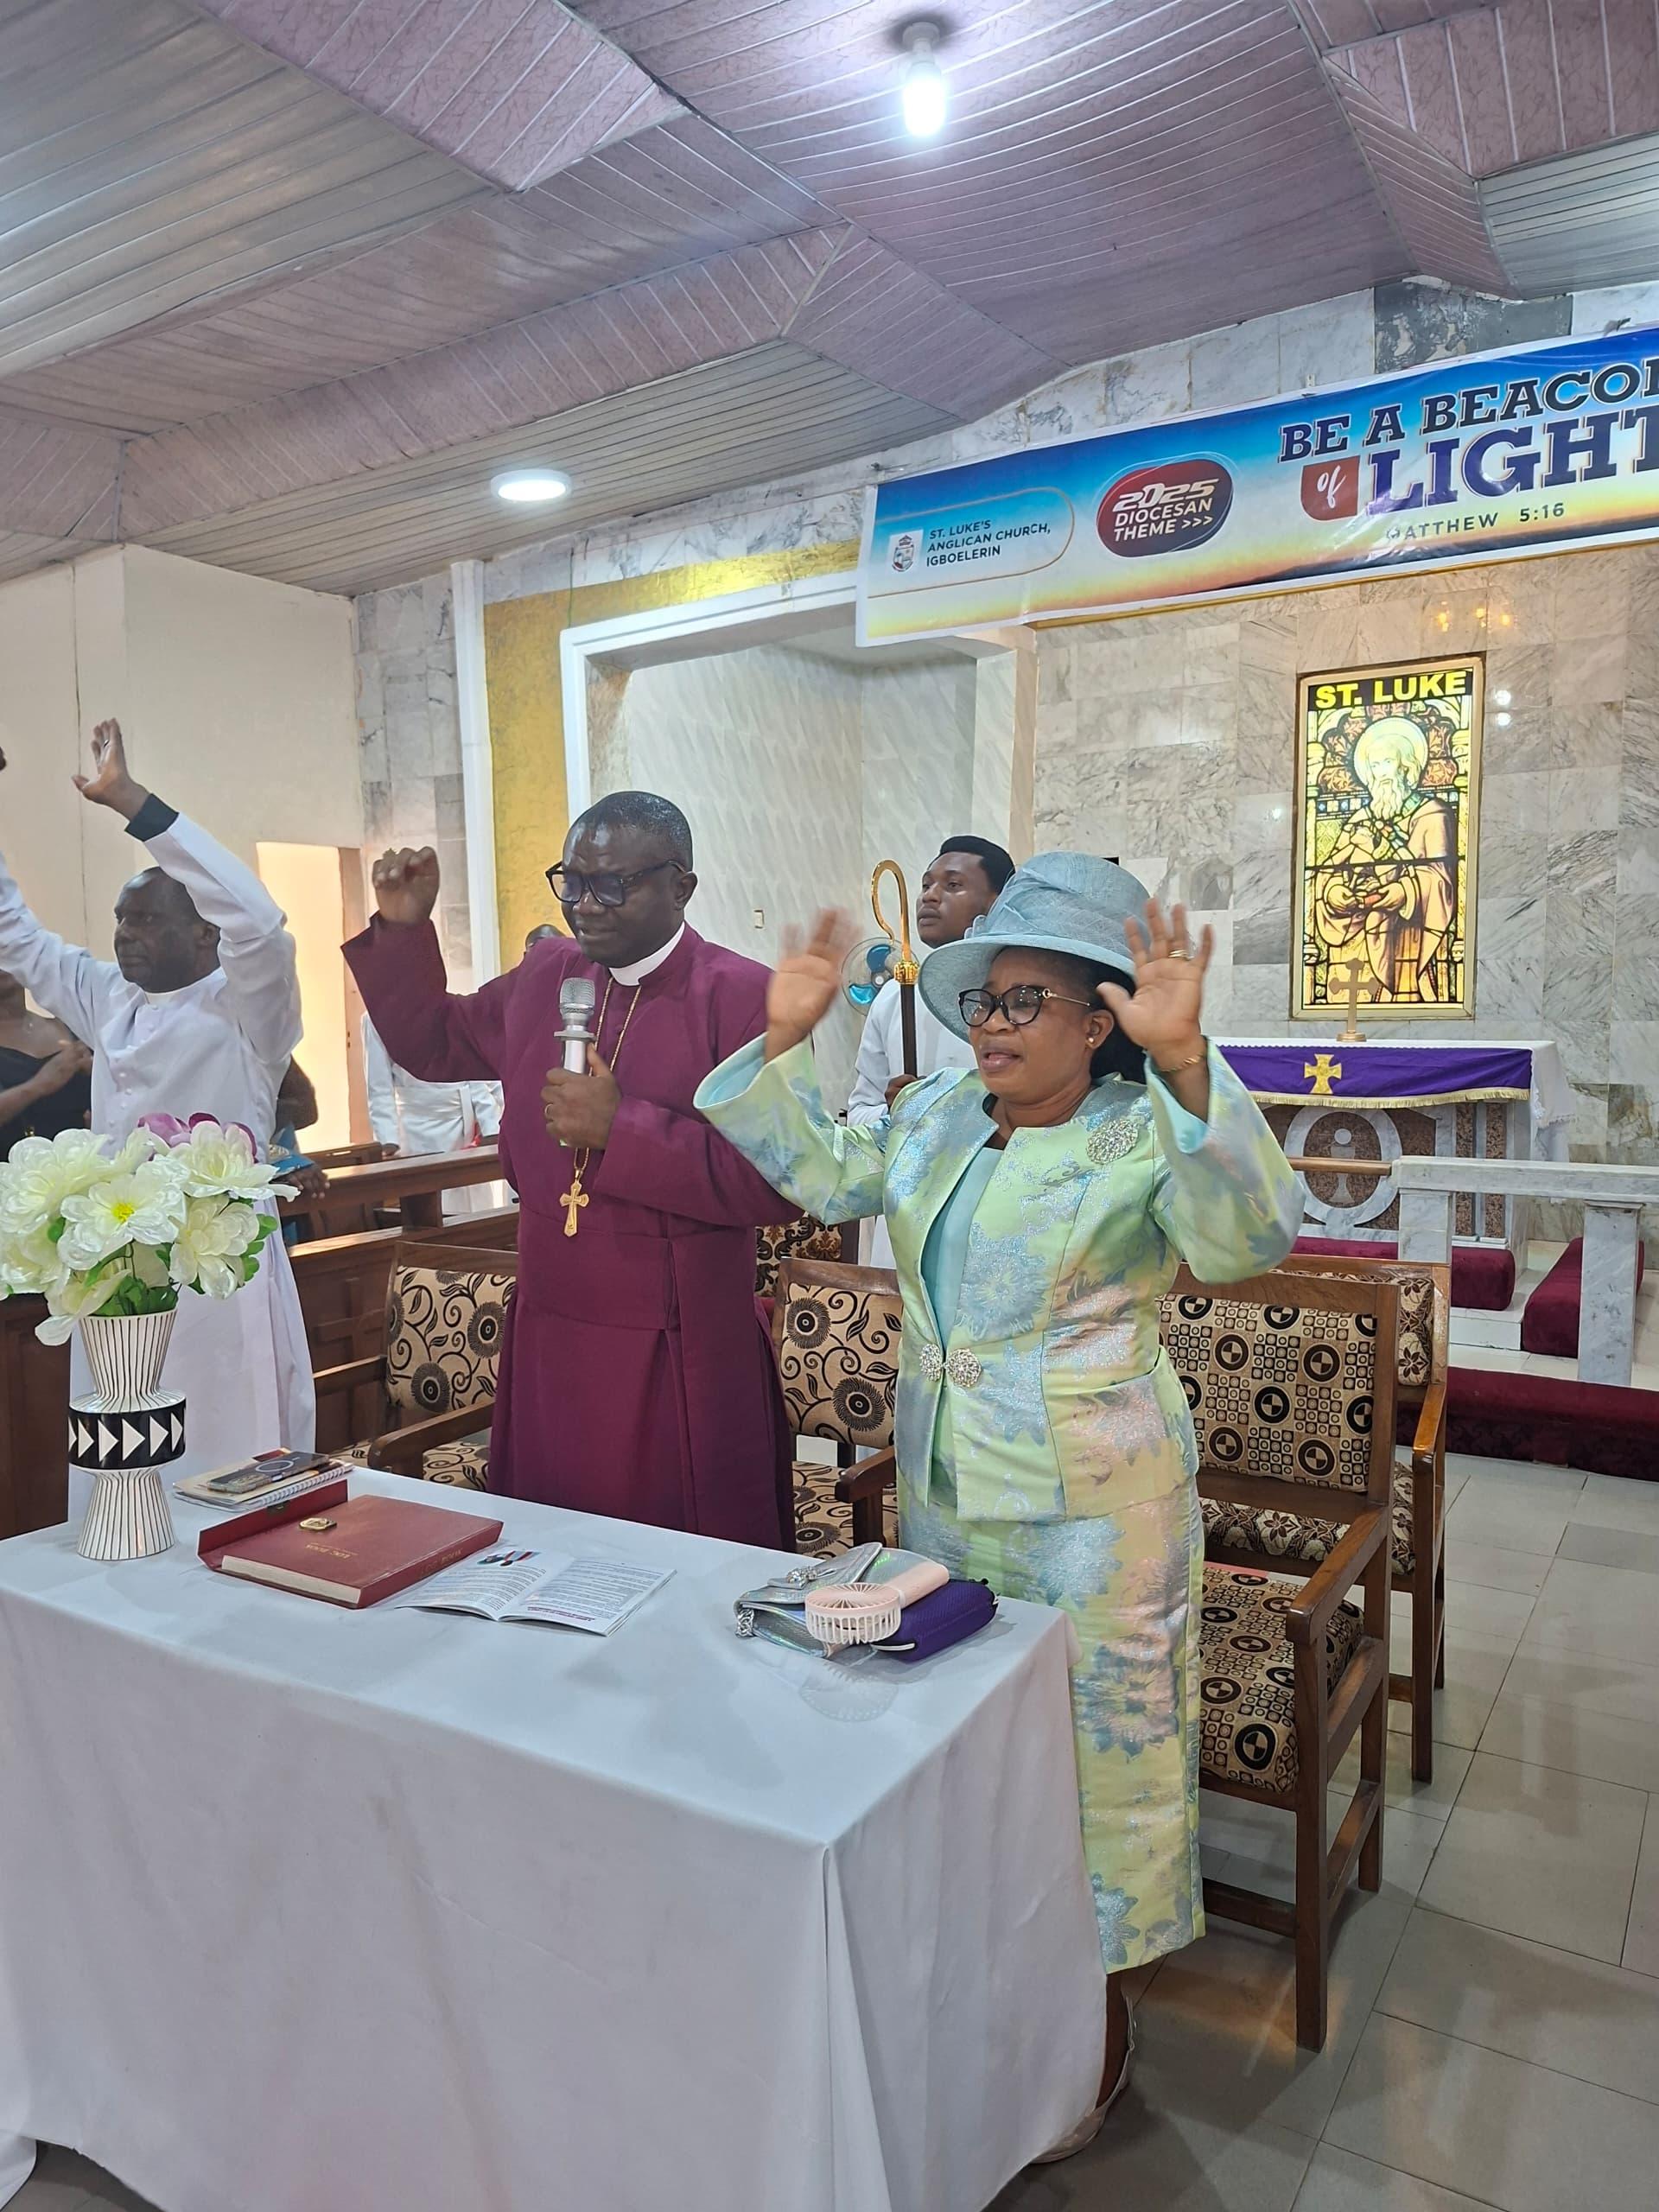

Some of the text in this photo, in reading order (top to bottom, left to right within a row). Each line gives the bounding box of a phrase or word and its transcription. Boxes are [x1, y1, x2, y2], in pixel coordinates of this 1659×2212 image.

[1279, 415, 1351, 463] BE
[1363, 404, 1405, 446] A
[1113, 479, 1219, 512] 2025
[1316, 467, 1344, 508] of
[1115, 498, 1212, 527] DIOCESAN
[1519, 503, 1565, 522] 5:16
[927, 524, 1051, 552] ANGLICAN CHURCH,
[930, 520, 991, 539] ST. LUKE'S
[1114, 519, 1177, 542] THEME
[926, 545, 1001, 567] IGBOELERIN
[1315, 671, 1466, 709] ST. LUKE
